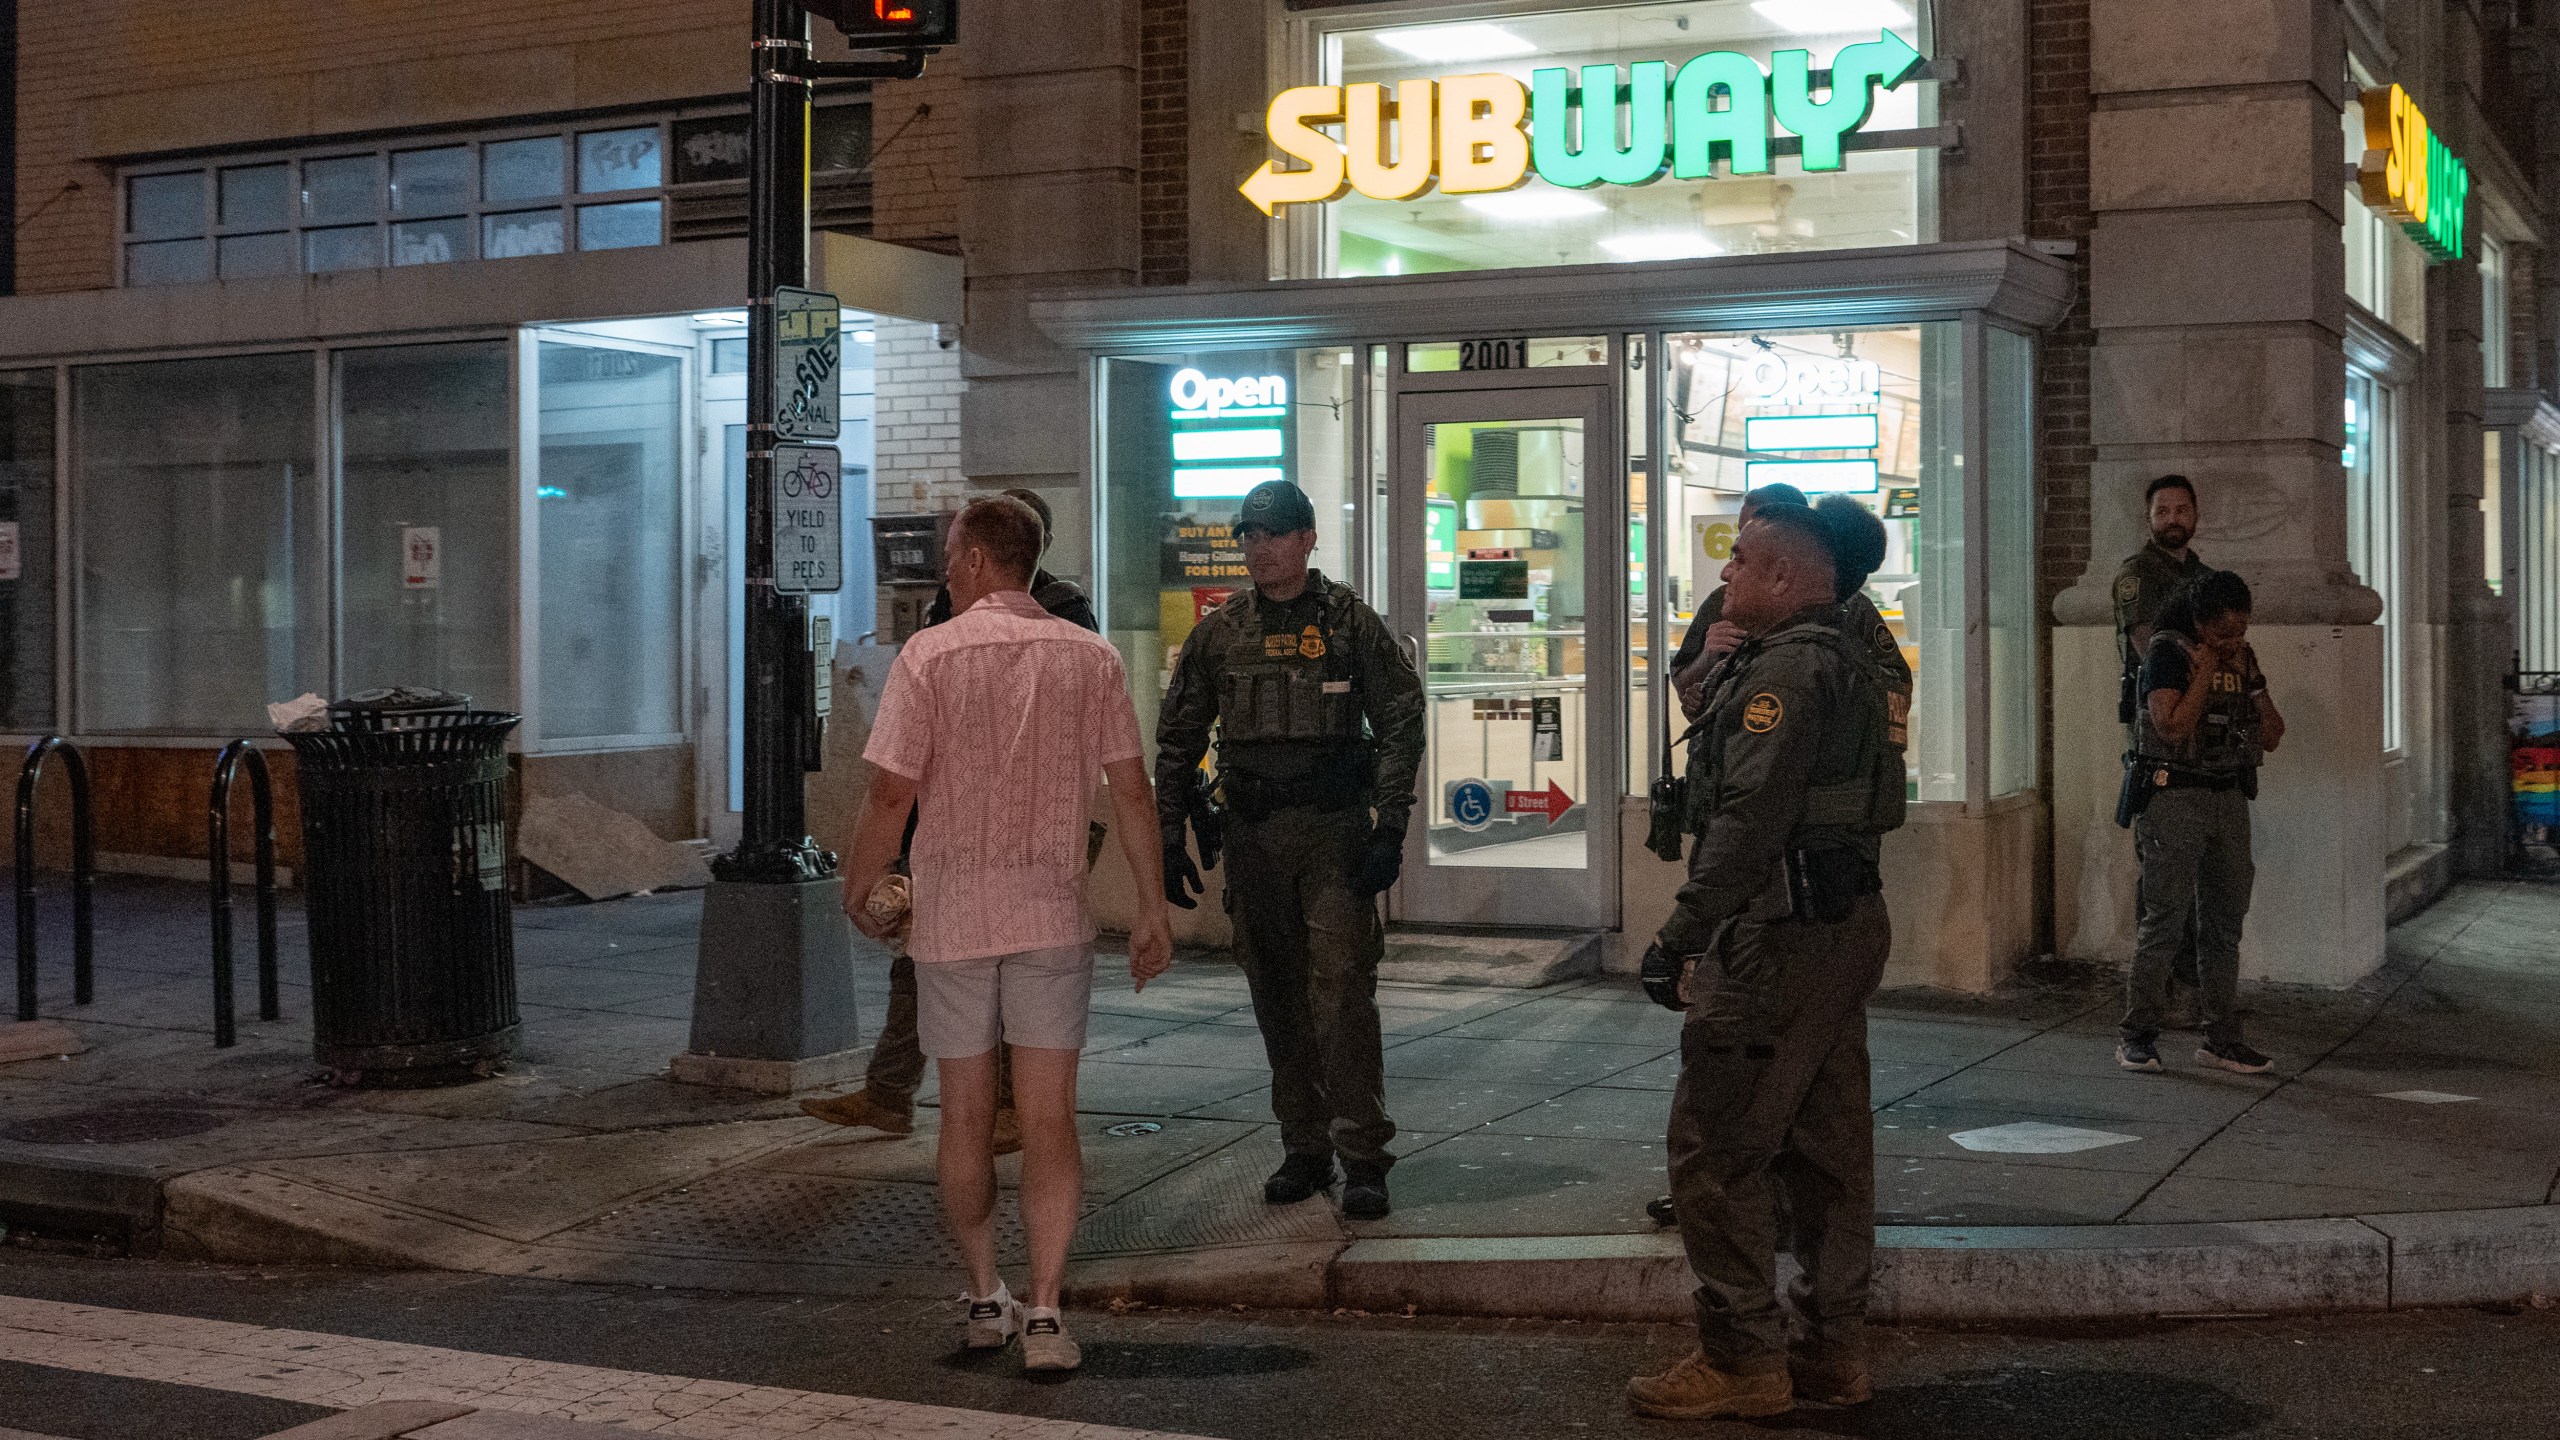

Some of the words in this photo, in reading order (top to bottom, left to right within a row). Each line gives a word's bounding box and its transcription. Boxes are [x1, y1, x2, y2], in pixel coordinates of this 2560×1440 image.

[1238, 27, 1923, 217] SUBWAY
[2386, 83, 2469, 259] SUBWAY
[1461, 341, 1526, 371] 2001
[1743, 350, 1880, 405] Open
[1170, 367, 1286, 419] Open
[787, 509, 825, 528] YIELD
[1179, 527, 1205, 538] BUY
[1206, 527, 1233, 538] ANY
[800, 535, 816, 554] TO
[792, 560, 826, 579] PEDS
[1184, 565, 1210, 576] FOR
[1211, 565, 1225, 577] $1
[2212, 672, 2242, 693] FBI
[1508, 795, 1516, 808] U
[1518, 796, 1549, 808] Street
